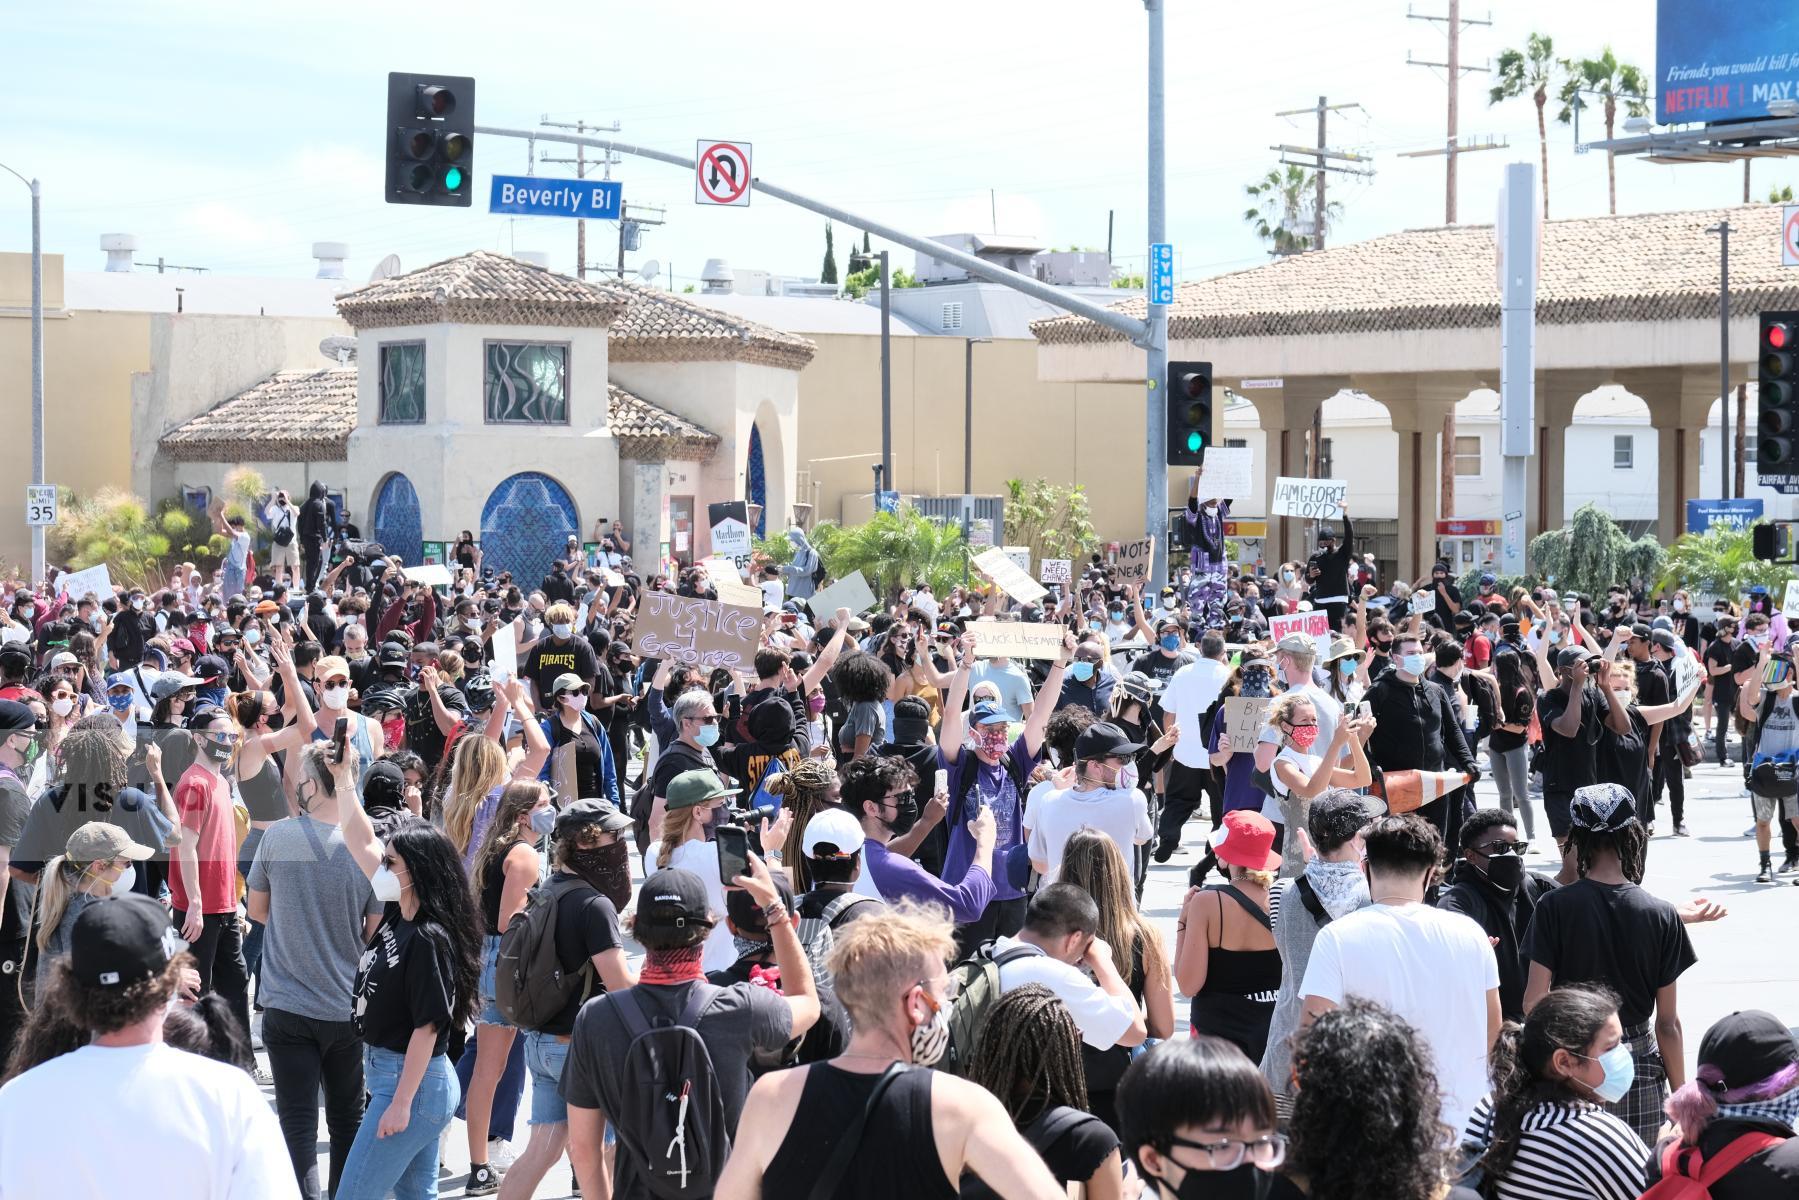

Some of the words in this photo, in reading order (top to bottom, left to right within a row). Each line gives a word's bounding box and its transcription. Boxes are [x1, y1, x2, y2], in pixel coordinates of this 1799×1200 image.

[1667, 63, 1708, 81] Friends
[1709, 65, 1729, 79] you
[1731, 56, 1767, 73] would
[1768, 54, 1787, 70] kill
[1665, 84, 1729, 113] NETFLIX
[1752, 80, 1792, 102] MAY
[501, 183, 582, 212] Beverly
[591, 188, 611, 209] Bl
[1160, 247, 1171, 302] SYNC
[1757, 474, 1786, 485] FAIRFAX
[31, 506, 53, 521] 35
[1287, 501, 1336, 519] FLOYD
[1707, 514, 1743, 526] EARN
[715, 524, 745, 541] Marlboro
[1120, 542, 1143, 558] NOT
[1041, 573, 1071, 581] CHANGE
[1045, 566, 1068, 575] NEED
[1117, 563, 1143, 579] NEAR
[674, 623, 696, 650] 4
[539, 653, 575, 670] PIRATES
